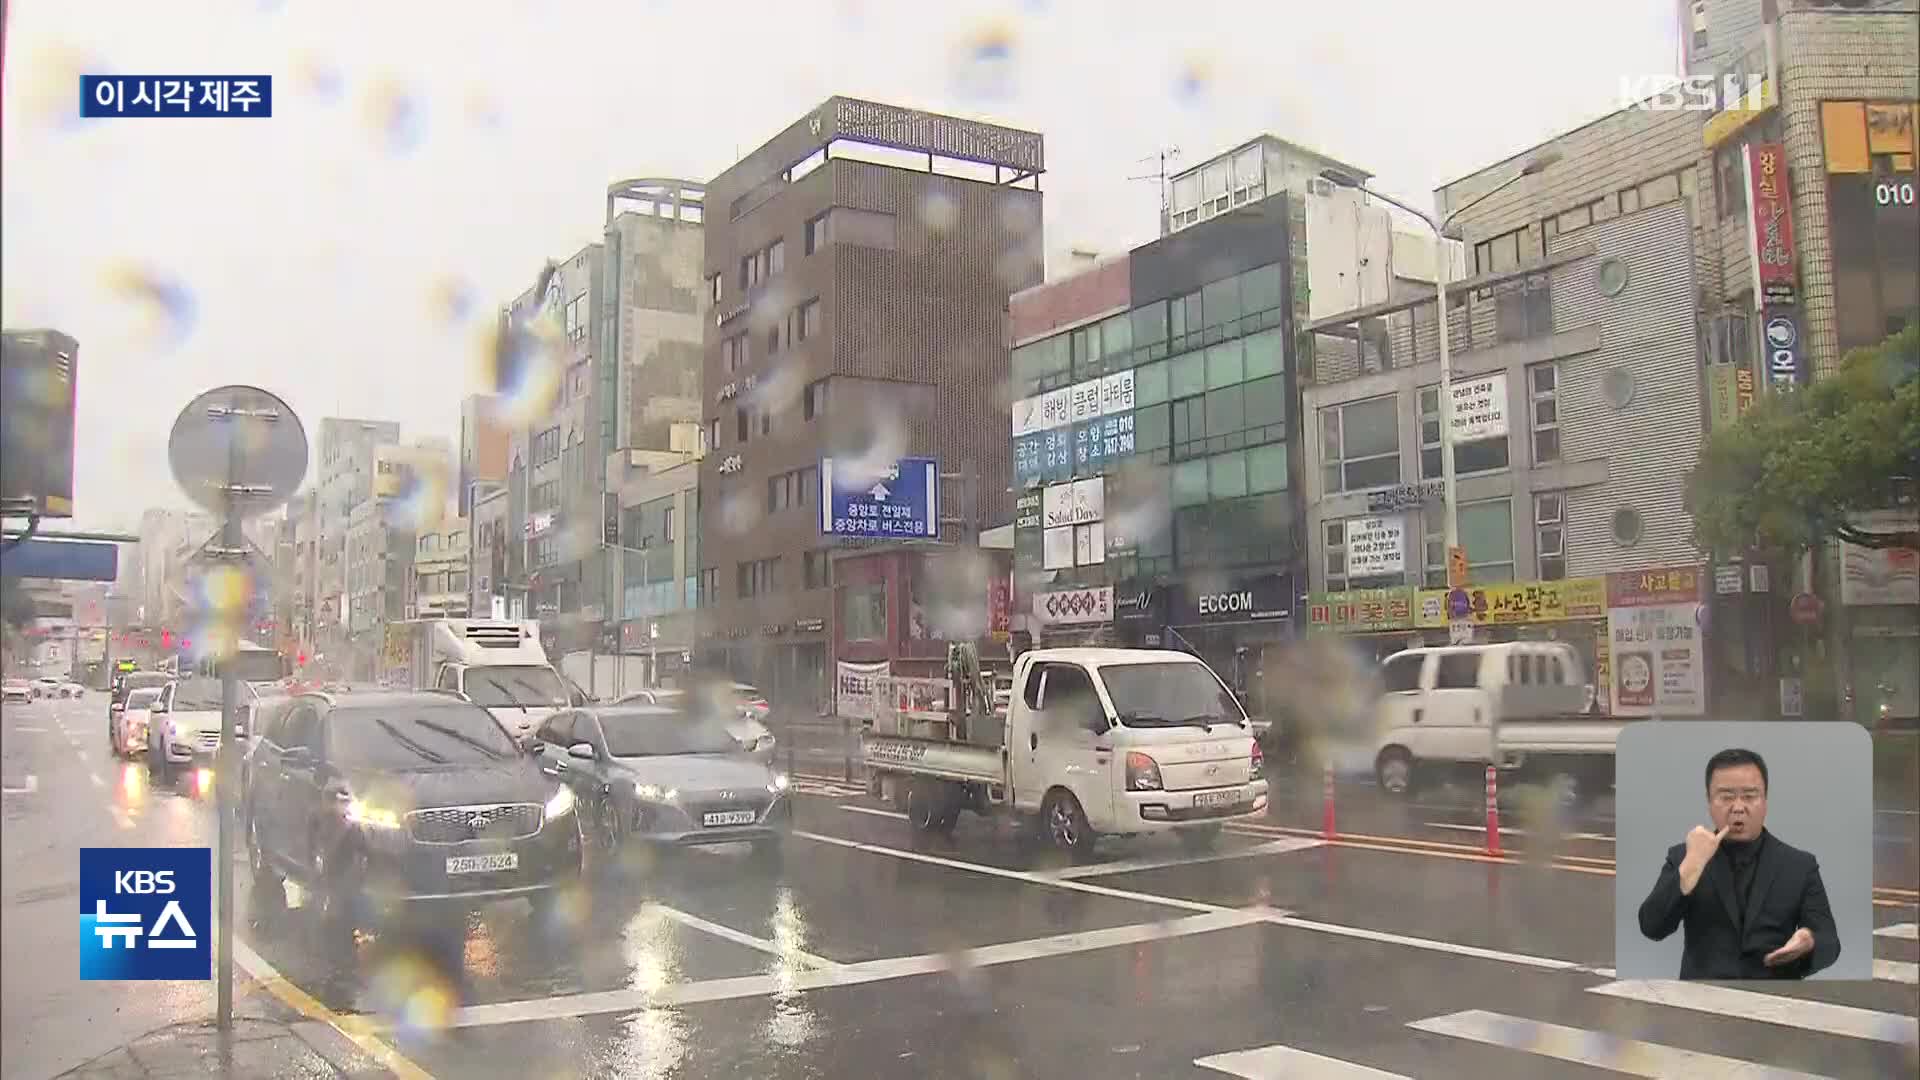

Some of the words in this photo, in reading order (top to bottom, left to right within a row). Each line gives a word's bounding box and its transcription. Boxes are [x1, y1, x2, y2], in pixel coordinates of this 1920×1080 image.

[1876, 183, 1913, 205] 010
[1074, 385, 1099, 416] 클럽
[848, 504, 878, 518] 중앙로
[1048, 508, 1073, 526] Salad
[835, 518, 878, 532] 중앙차로
[882, 520, 924, 535] 버스전용
[1199, 591, 1252, 614] ECCOM
[1494, 587, 1562, 617] 사고팔고
